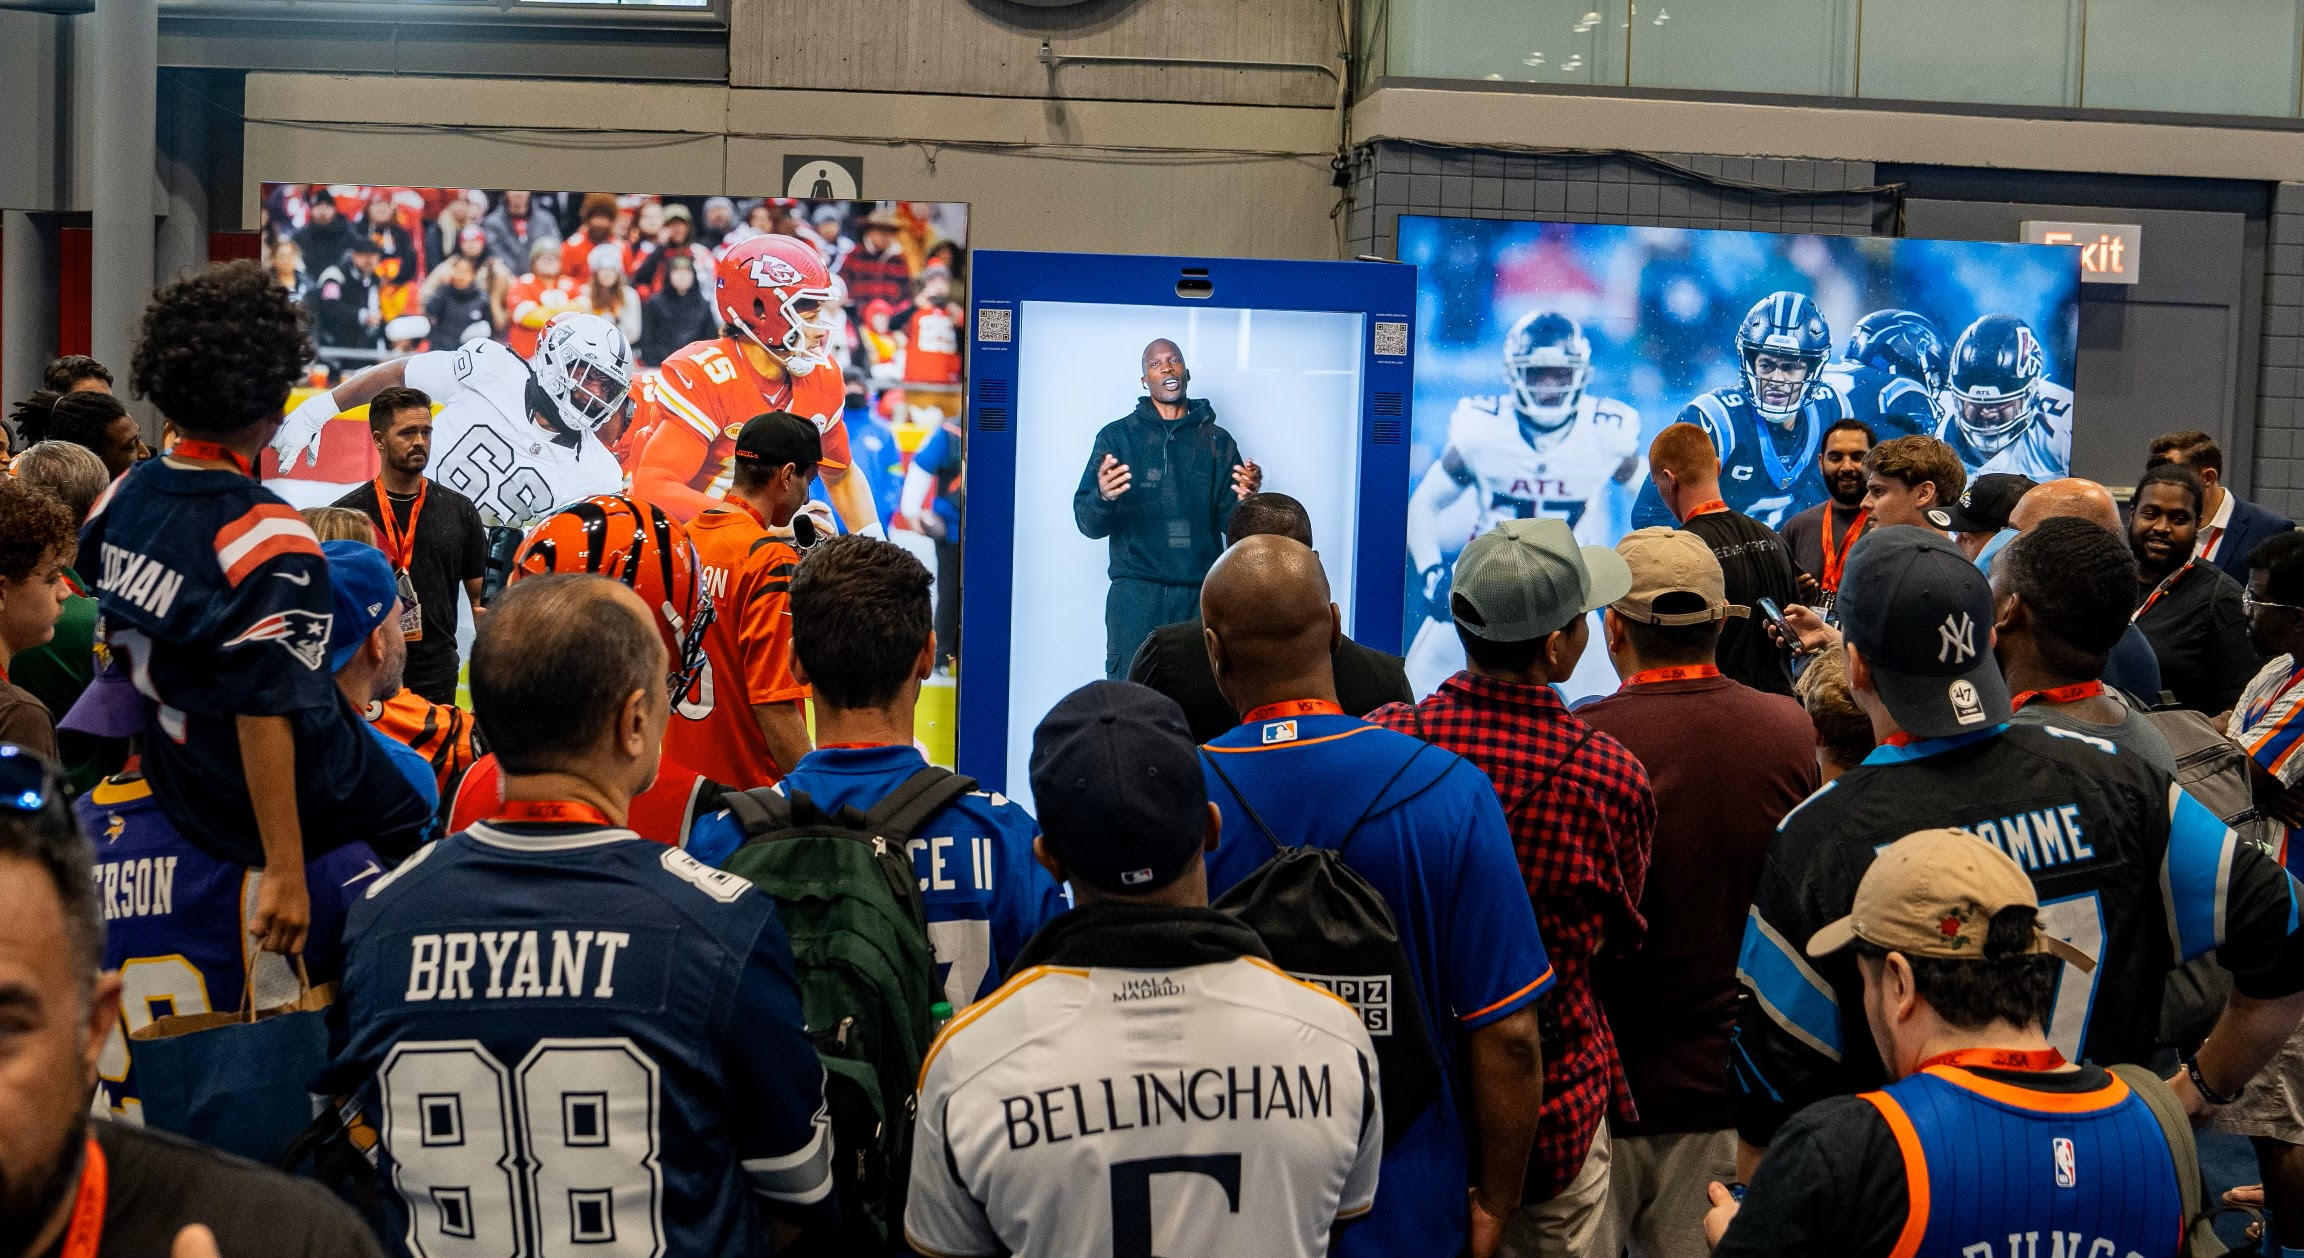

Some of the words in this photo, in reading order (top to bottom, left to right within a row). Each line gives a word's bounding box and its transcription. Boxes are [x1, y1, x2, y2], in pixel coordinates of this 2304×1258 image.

[688, 346, 738, 385] 15
[1510, 479, 1570, 496] ATL
[1731, 464, 1754, 481] C
[701, 564, 729, 599] ON
[971, 837, 993, 891] II
[405, 930, 631, 1002] BRYANT
[1313, 980, 1384, 1002] PZ
[1002, 1064, 1333, 1150] BELLINGHAM
[377, 1037, 667, 1258] 88
